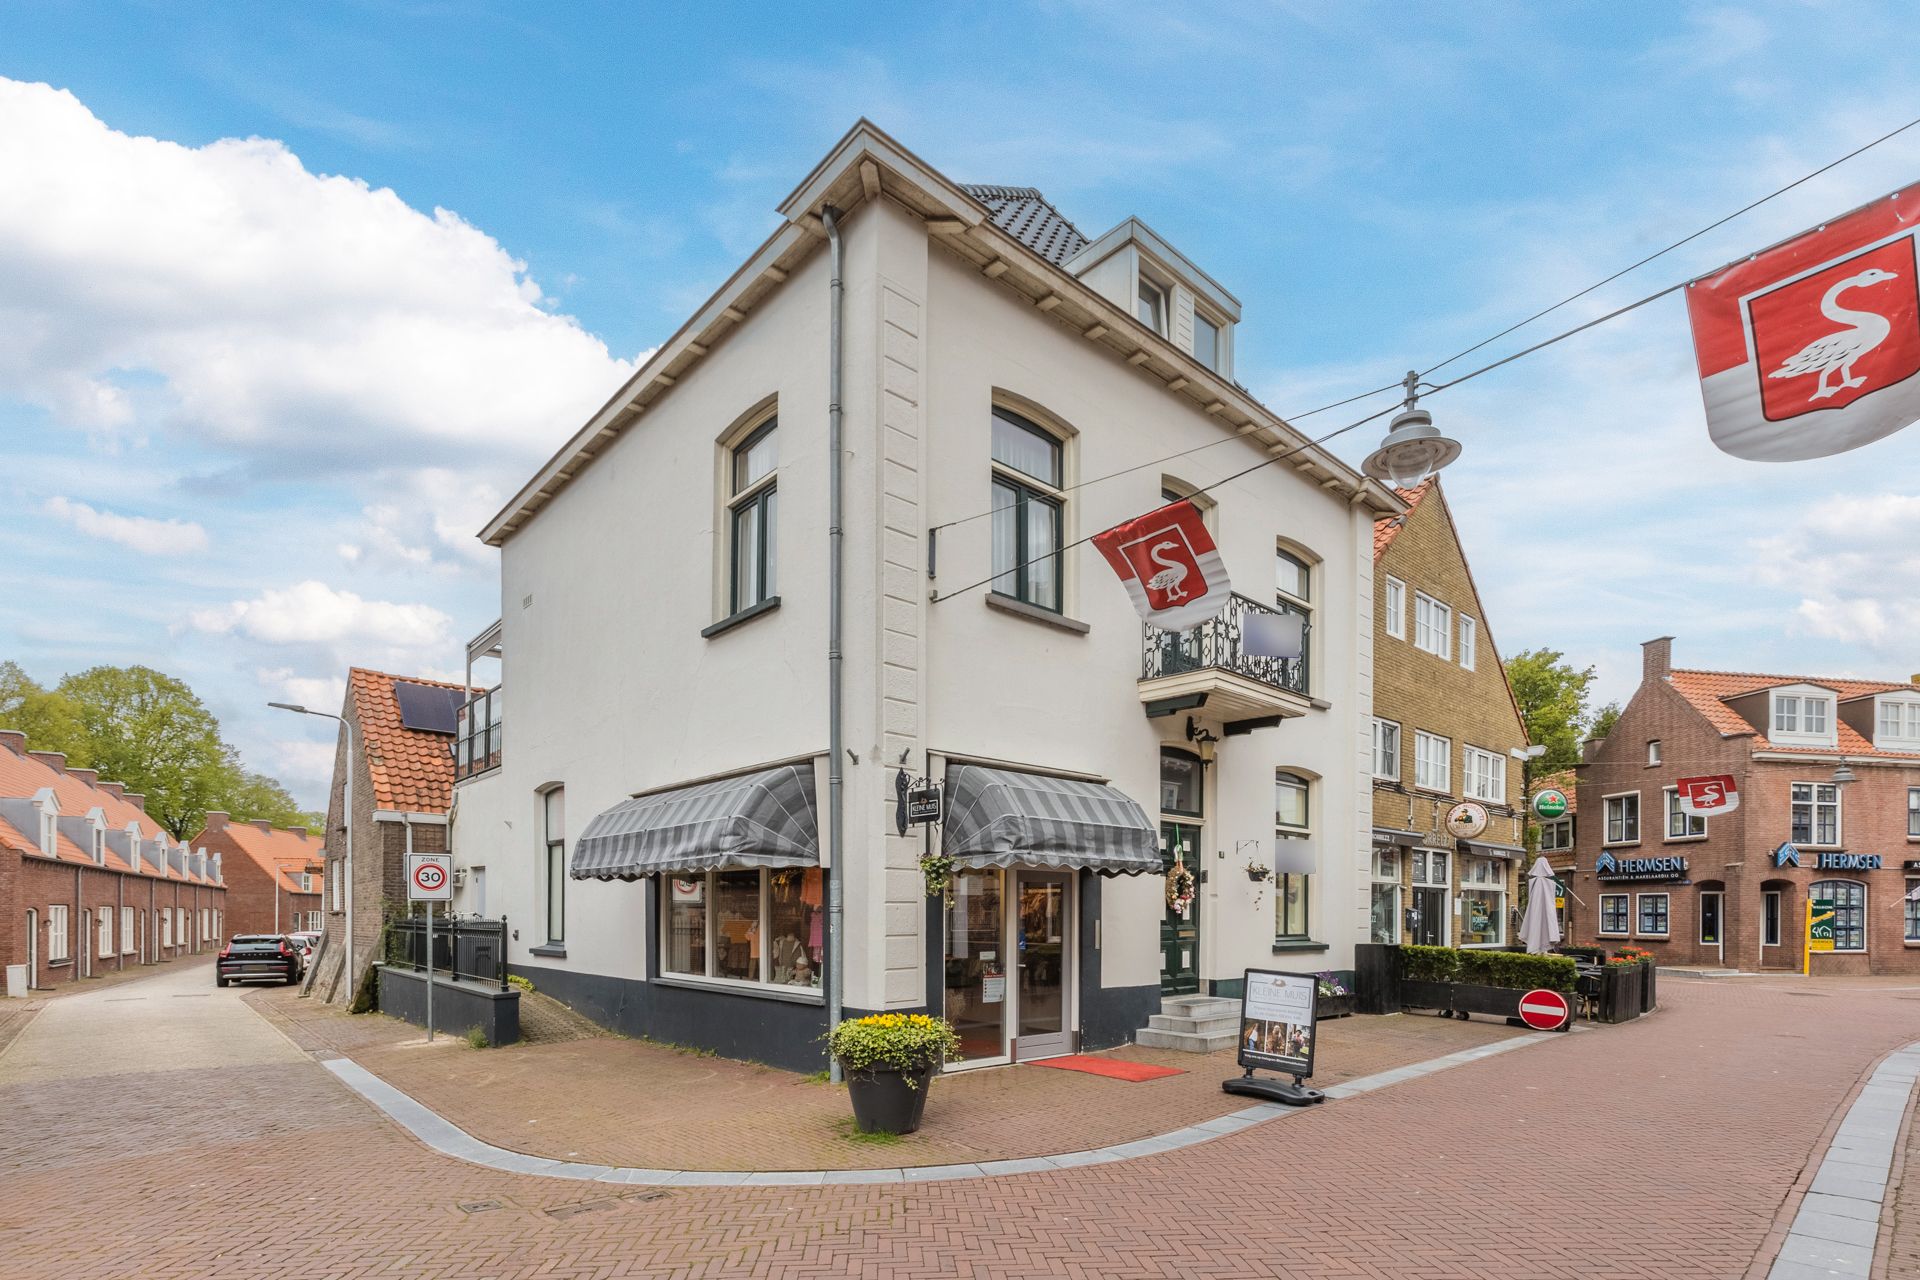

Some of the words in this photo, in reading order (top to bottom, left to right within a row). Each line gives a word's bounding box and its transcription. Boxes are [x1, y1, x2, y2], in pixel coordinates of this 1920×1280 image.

[1619, 857, 1682, 873] HERMSEN
[1822, 853, 1883, 869] HERMSEN
[420, 872, 441, 882] 30
[1252, 986, 1281, 998] KLEINE
[1284, 989, 1307, 1001] MUIS
